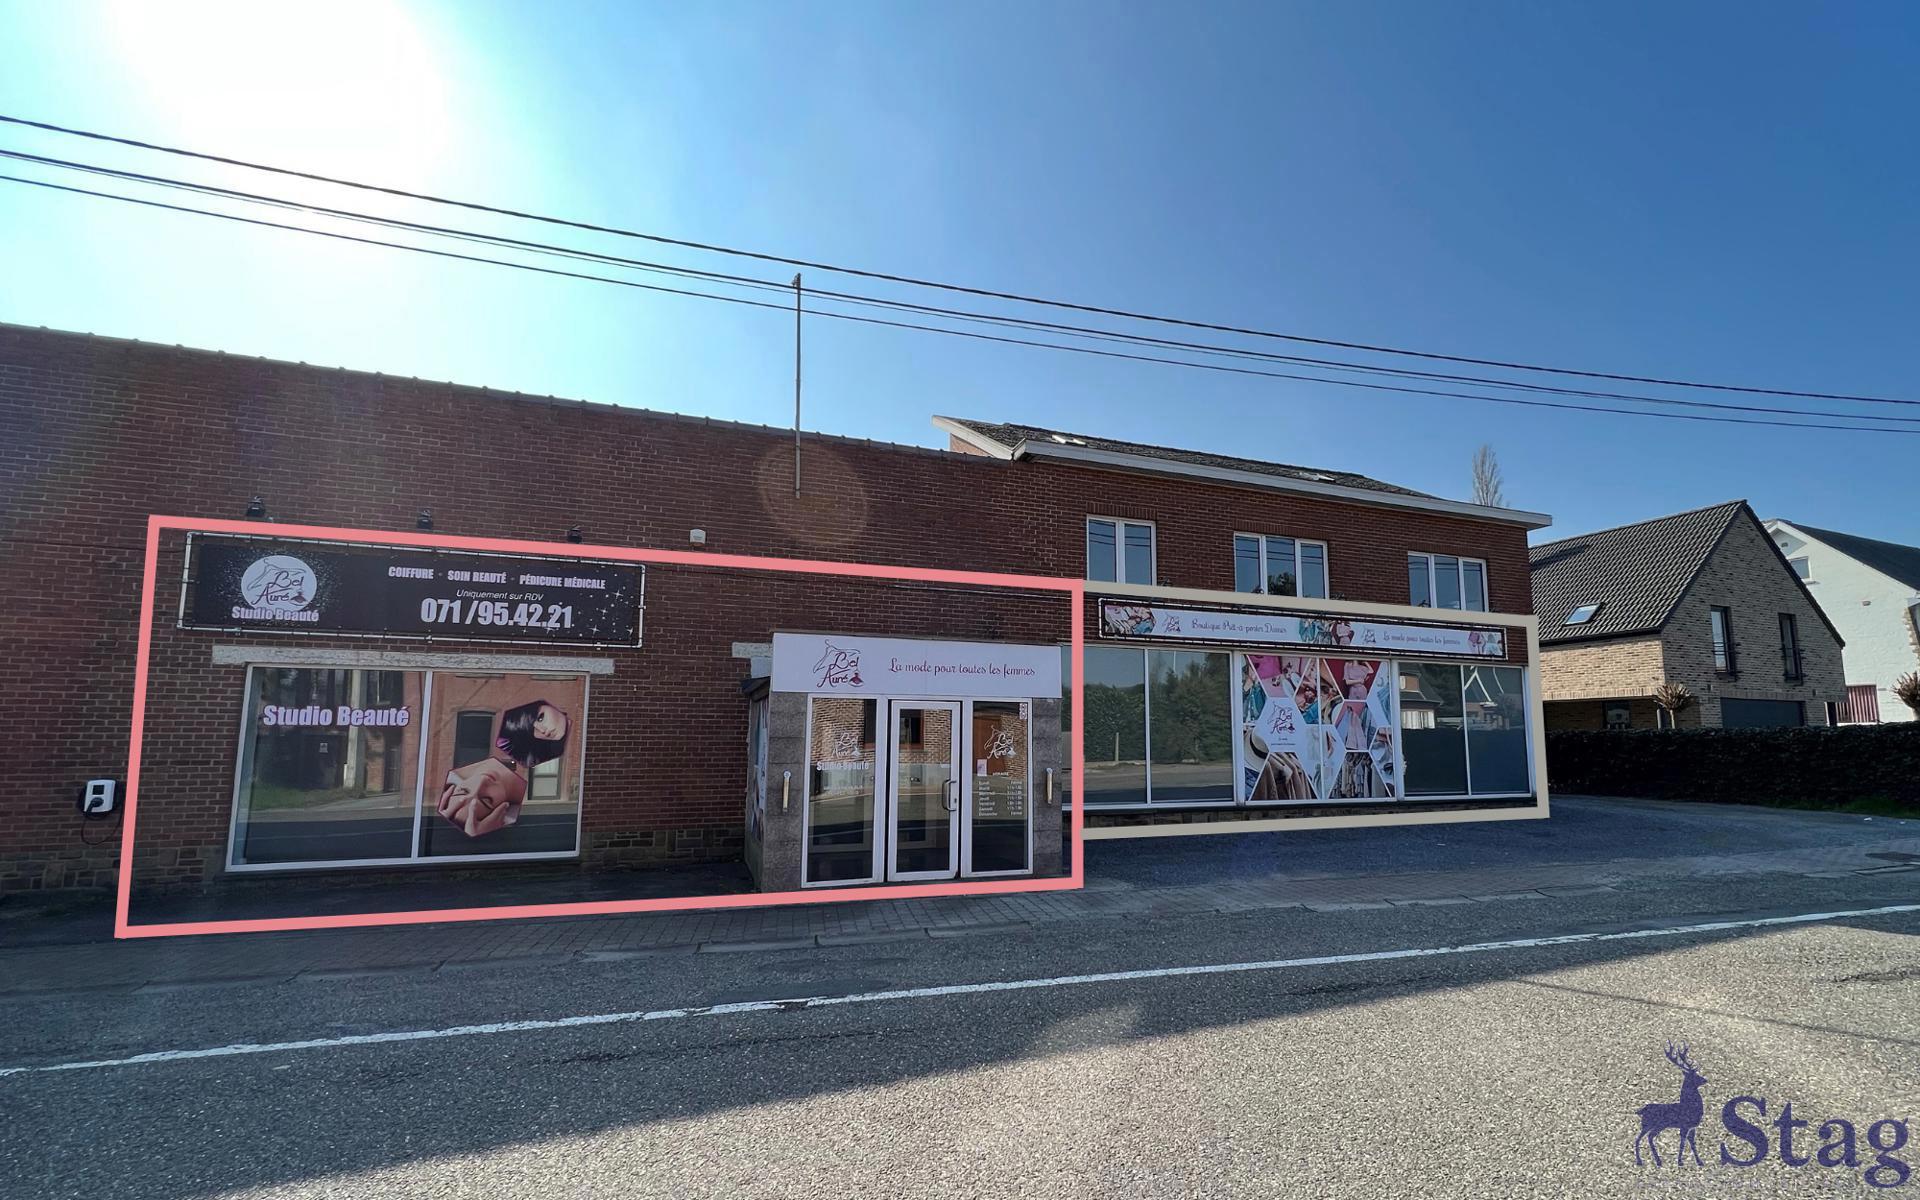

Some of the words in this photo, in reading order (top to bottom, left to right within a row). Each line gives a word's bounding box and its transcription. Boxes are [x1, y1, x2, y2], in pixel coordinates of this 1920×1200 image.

[268, 570, 304, 588] Bel
[388, 566, 434, 580] COIFFURE
[447, 570, 471, 582] SOIN
[472, 571, 507, 584] BEAUTÉ
[519, 573, 563, 587] PÉDICURE
[564, 576, 606, 590] MÉDICALE
[456, 589, 508, 601] Uniquement
[509, 593, 523, 601] sur
[525, 593, 545, 601] RDV
[231, 606, 274, 620] Studio
[275, 608, 319, 622] Beauté
[829, 651, 859, 670] Bel
[888, 657, 902, 673] La
[905, 660, 932, 673] mode
[934, 665, 956, 677] pour
[959, 663, 987, 675] toutes
[989, 662, 1001, 675] les
[1003, 663, 1035, 678] femmes
[263, 704, 333, 726] Studio
[336, 706, 410, 726] Beauté
